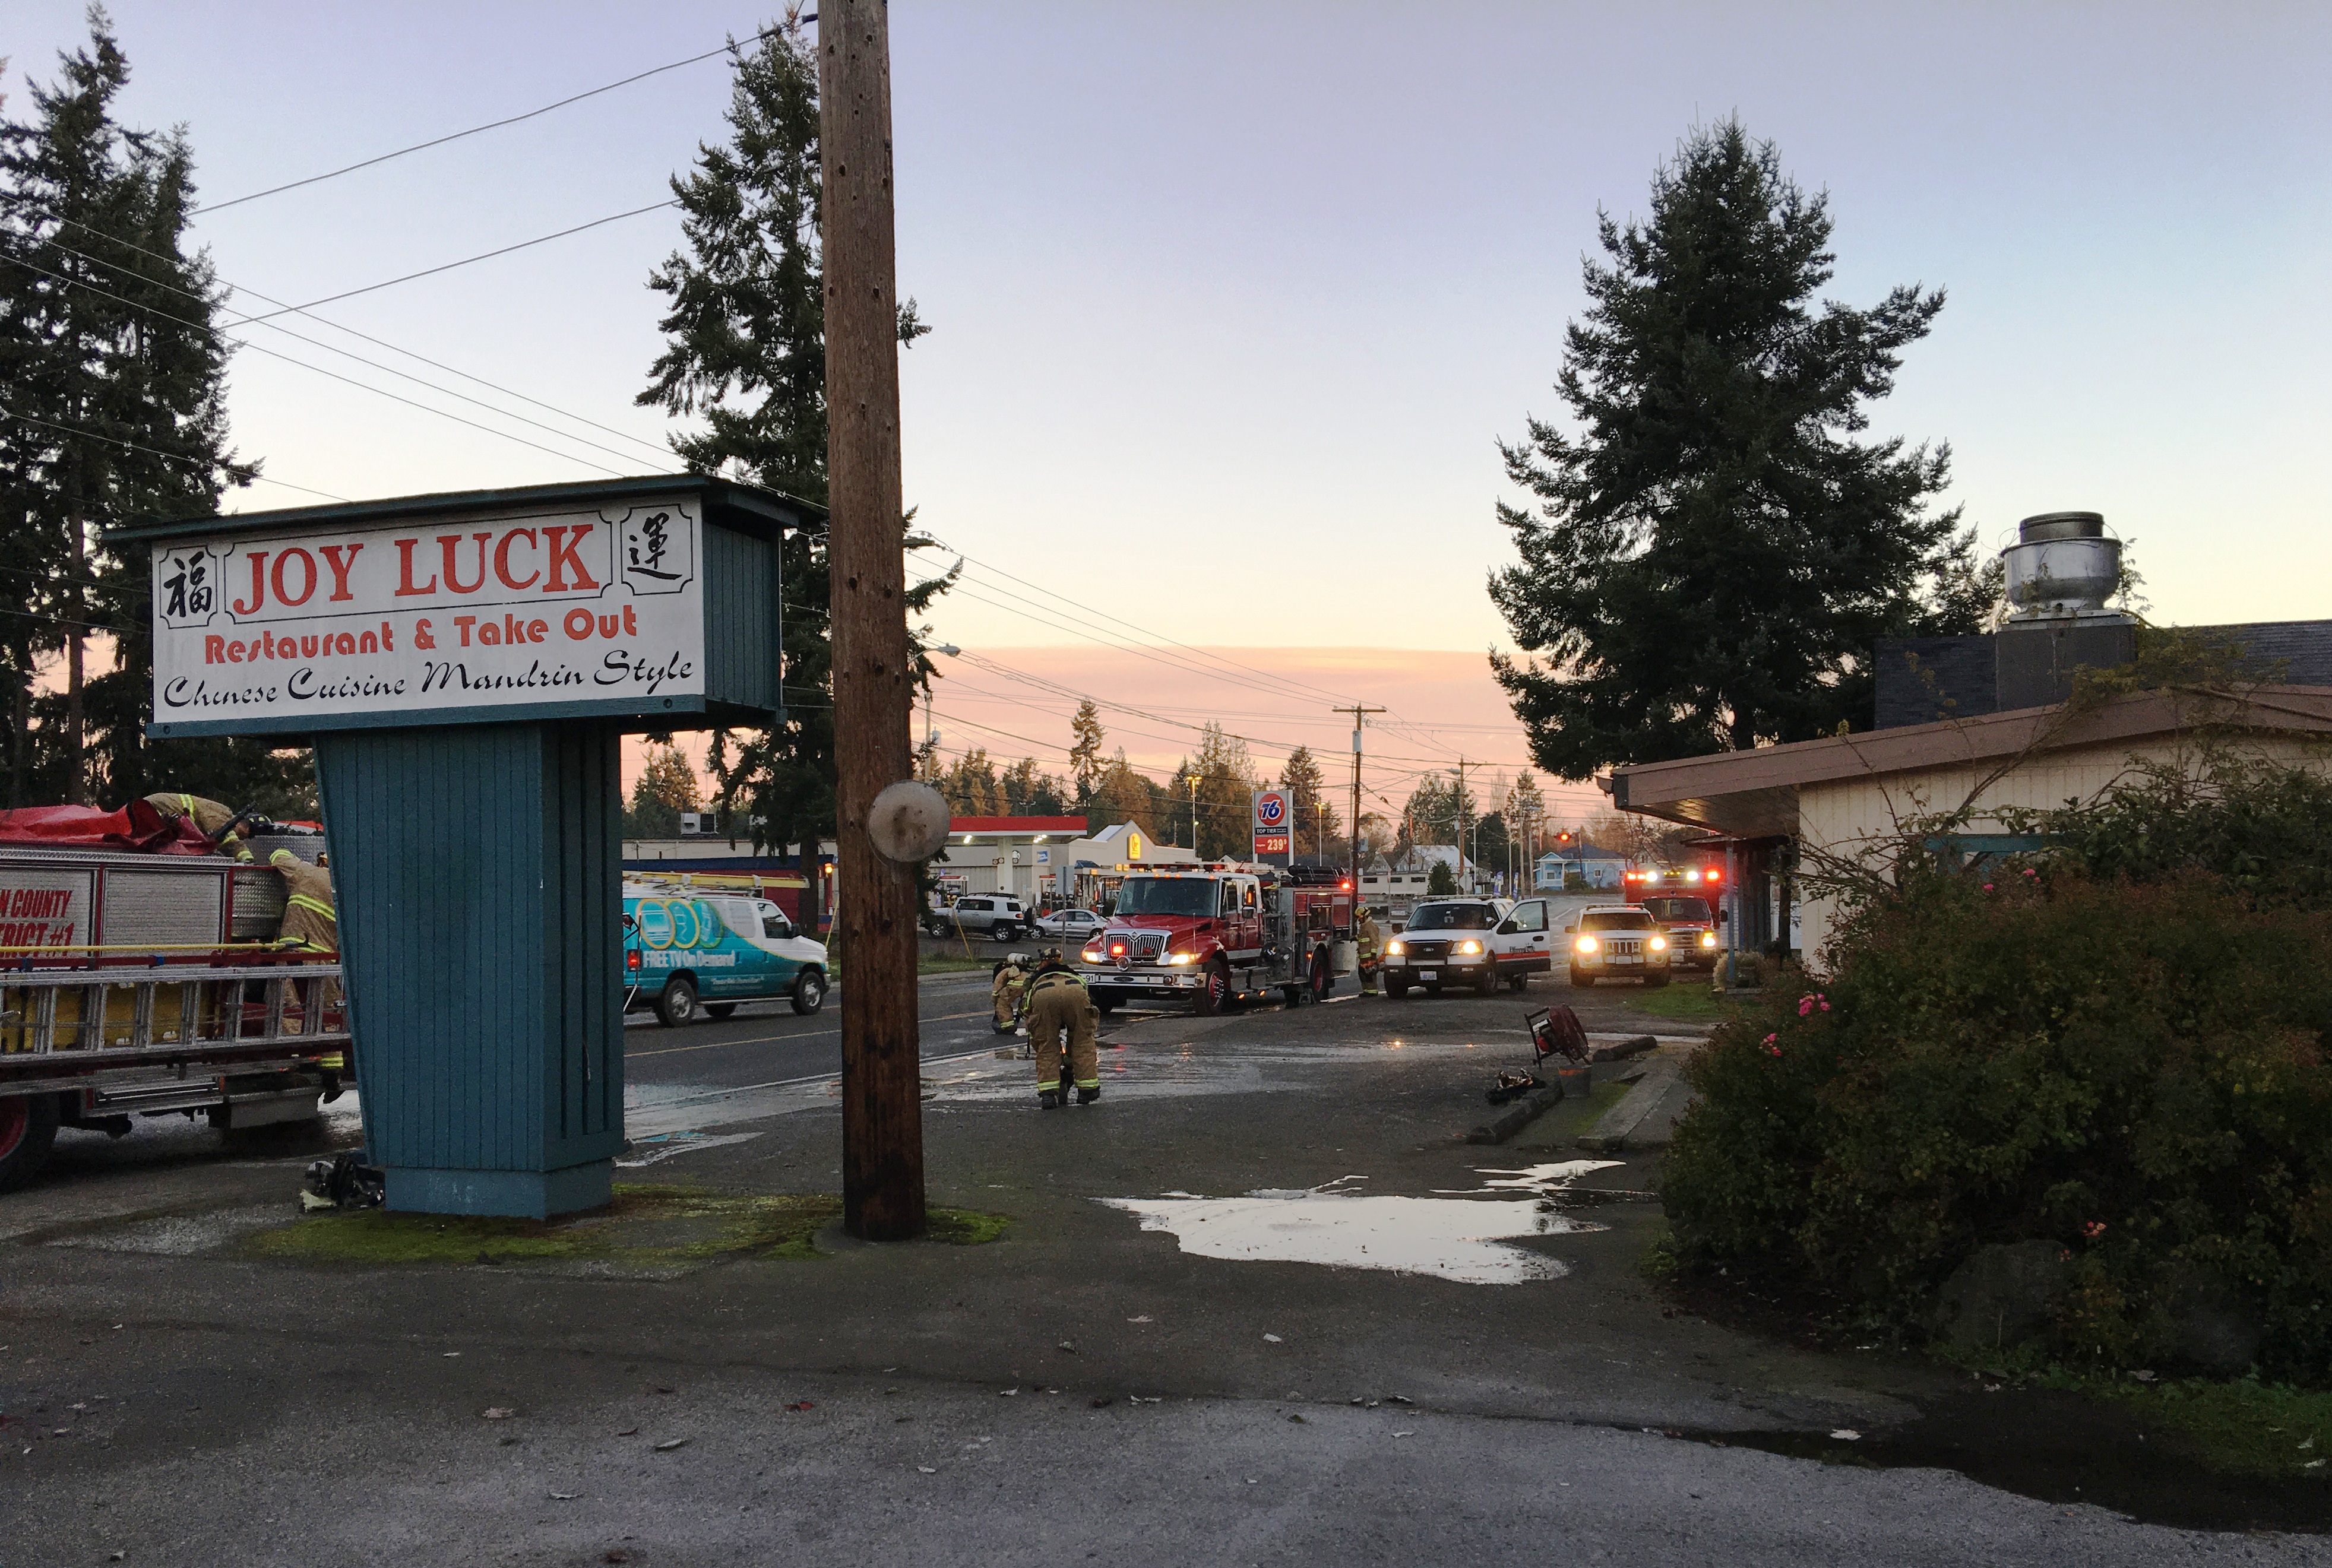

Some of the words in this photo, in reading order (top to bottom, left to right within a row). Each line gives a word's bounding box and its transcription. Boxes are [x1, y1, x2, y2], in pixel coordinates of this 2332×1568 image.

[164, 552, 213, 617] 福
[233, 544, 363, 615] JOY
[394, 524, 599, 596] LUCK
[205, 621, 394, 664] Restaurant
[414, 618, 436, 650] &
[454, 614, 549, 647] Take
[563, 604, 637, 641] Out
[163, 676, 278, 707] Chinese
[287, 667, 407, 700] Cuisine
[421, 660, 585, 693] Mandrin
[594, 650, 694, 695] Style
[1260, 799, 1281, 820] 76
[11, 889, 73, 918] COUNTY
[46, 923, 75, 957] #1
[643, 951, 669, 968] FREE
[669, 950, 682, 968] TV
[682, 950, 697, 967] On
[697, 949, 735, 967] Demand
